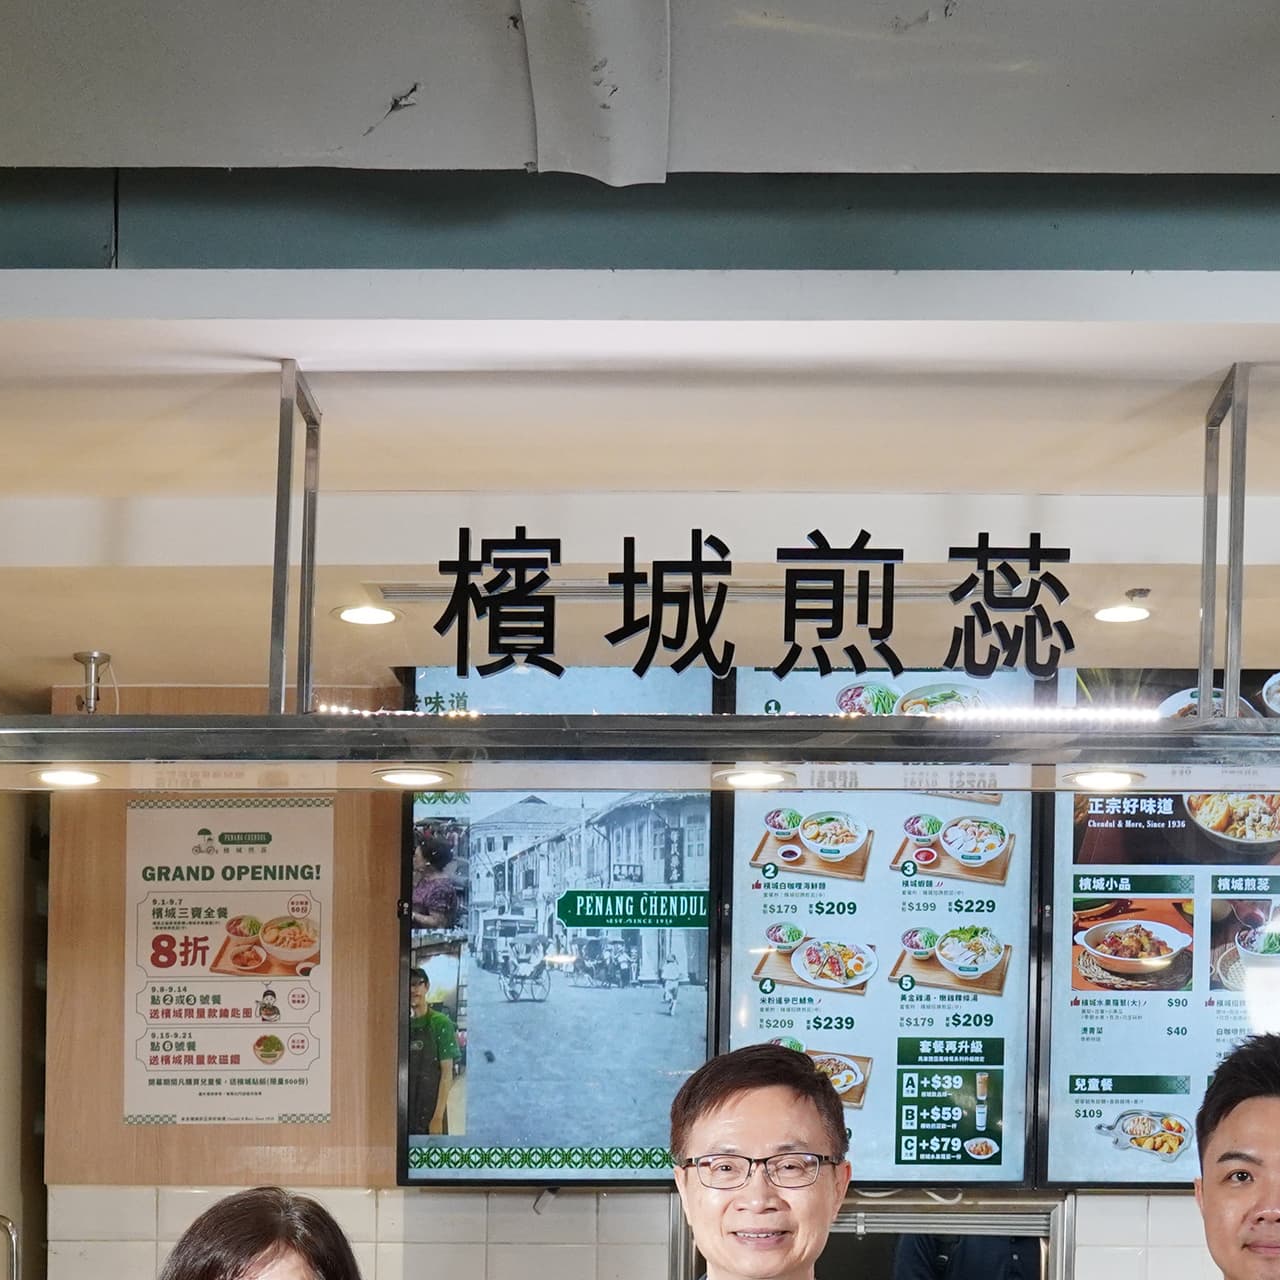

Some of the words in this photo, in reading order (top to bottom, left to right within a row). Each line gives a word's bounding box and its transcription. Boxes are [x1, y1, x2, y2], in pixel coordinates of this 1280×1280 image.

[433, 526, 1074, 680] 檳城煎蕊
[1087, 797, 1174, 815] 正宗好味道
[1146, 819, 1165, 828] Since
[142, 865, 215, 882] GRAND
[221, 864, 322, 881] OPENING!
[1079, 876, 1132, 892] 檳城小品
[1217, 877, 1270, 892] 檳城煎蕊
[151, 906, 229, 919] 檳城三寶全餐
[575, 895, 634, 916] PENANG
[639, 895, 707, 917] CHENDUL
[768, 904, 798, 914] $179
[815, 900, 857, 916] $209
[907, 902, 937, 912] $199
[954, 898, 996, 914] $229
[150, 934, 210, 968] 8折
[1167, 998, 1188, 1008] $90
[765, 1019, 794, 1029] $209
[812, 1015, 855, 1031] $239
[905, 1017, 935, 1027] $179
[951, 1012, 994, 1028] $209
[1166, 1026, 1188, 1037] $40
[919, 1040, 984, 1053] 套餐再升級
[920, 1074, 963, 1090] +$39
[1074, 1078, 1114, 1092] 兒童餐
[919, 1105, 963, 1122] +$59
[1074, 1109, 1103, 1119] $109
[919, 1136, 962, 1152] +$79
